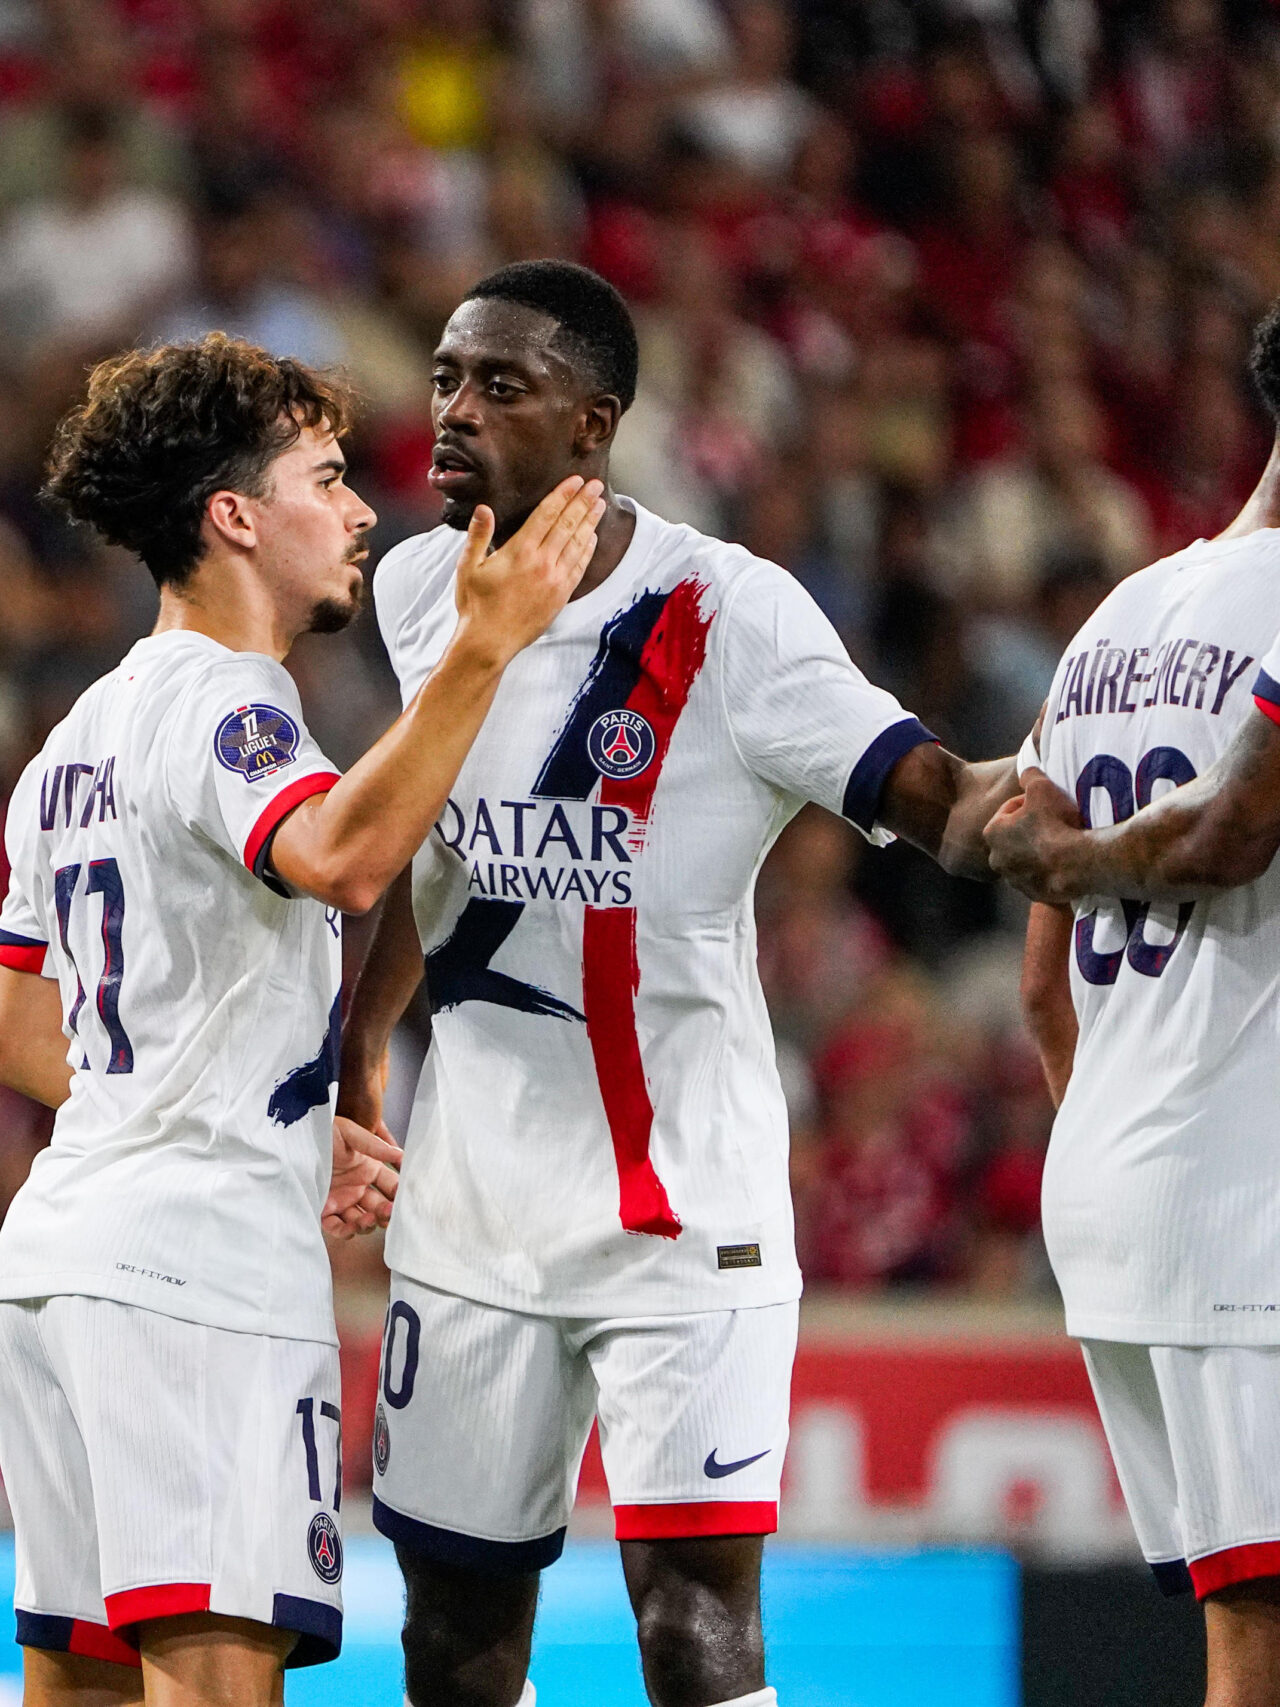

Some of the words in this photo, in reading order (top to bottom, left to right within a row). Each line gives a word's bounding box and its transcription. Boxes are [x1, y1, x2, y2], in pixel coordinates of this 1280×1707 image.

[600, 713, 644, 731] PARIS
[467, 860, 633, 905] AIRWAYS
[296, 1398, 342, 1514] 17
